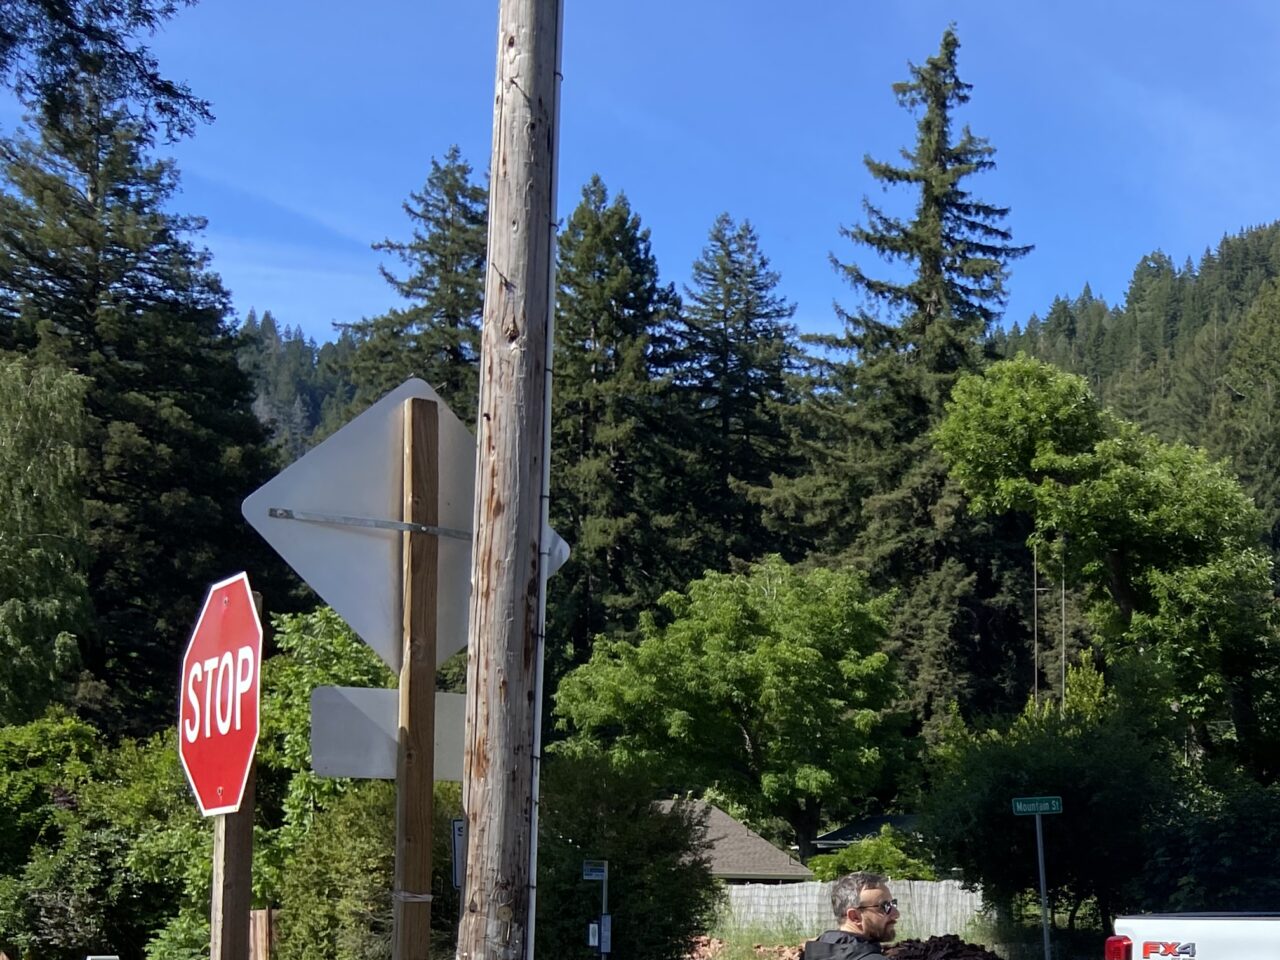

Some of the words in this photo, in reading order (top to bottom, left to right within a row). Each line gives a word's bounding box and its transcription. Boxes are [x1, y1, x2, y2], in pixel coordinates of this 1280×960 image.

[184, 645, 254, 744] STOP
[1016, 801, 1050, 812] Mountain
[1051, 800, 1060, 811] St
[1142, 941, 1197, 960] FX4
